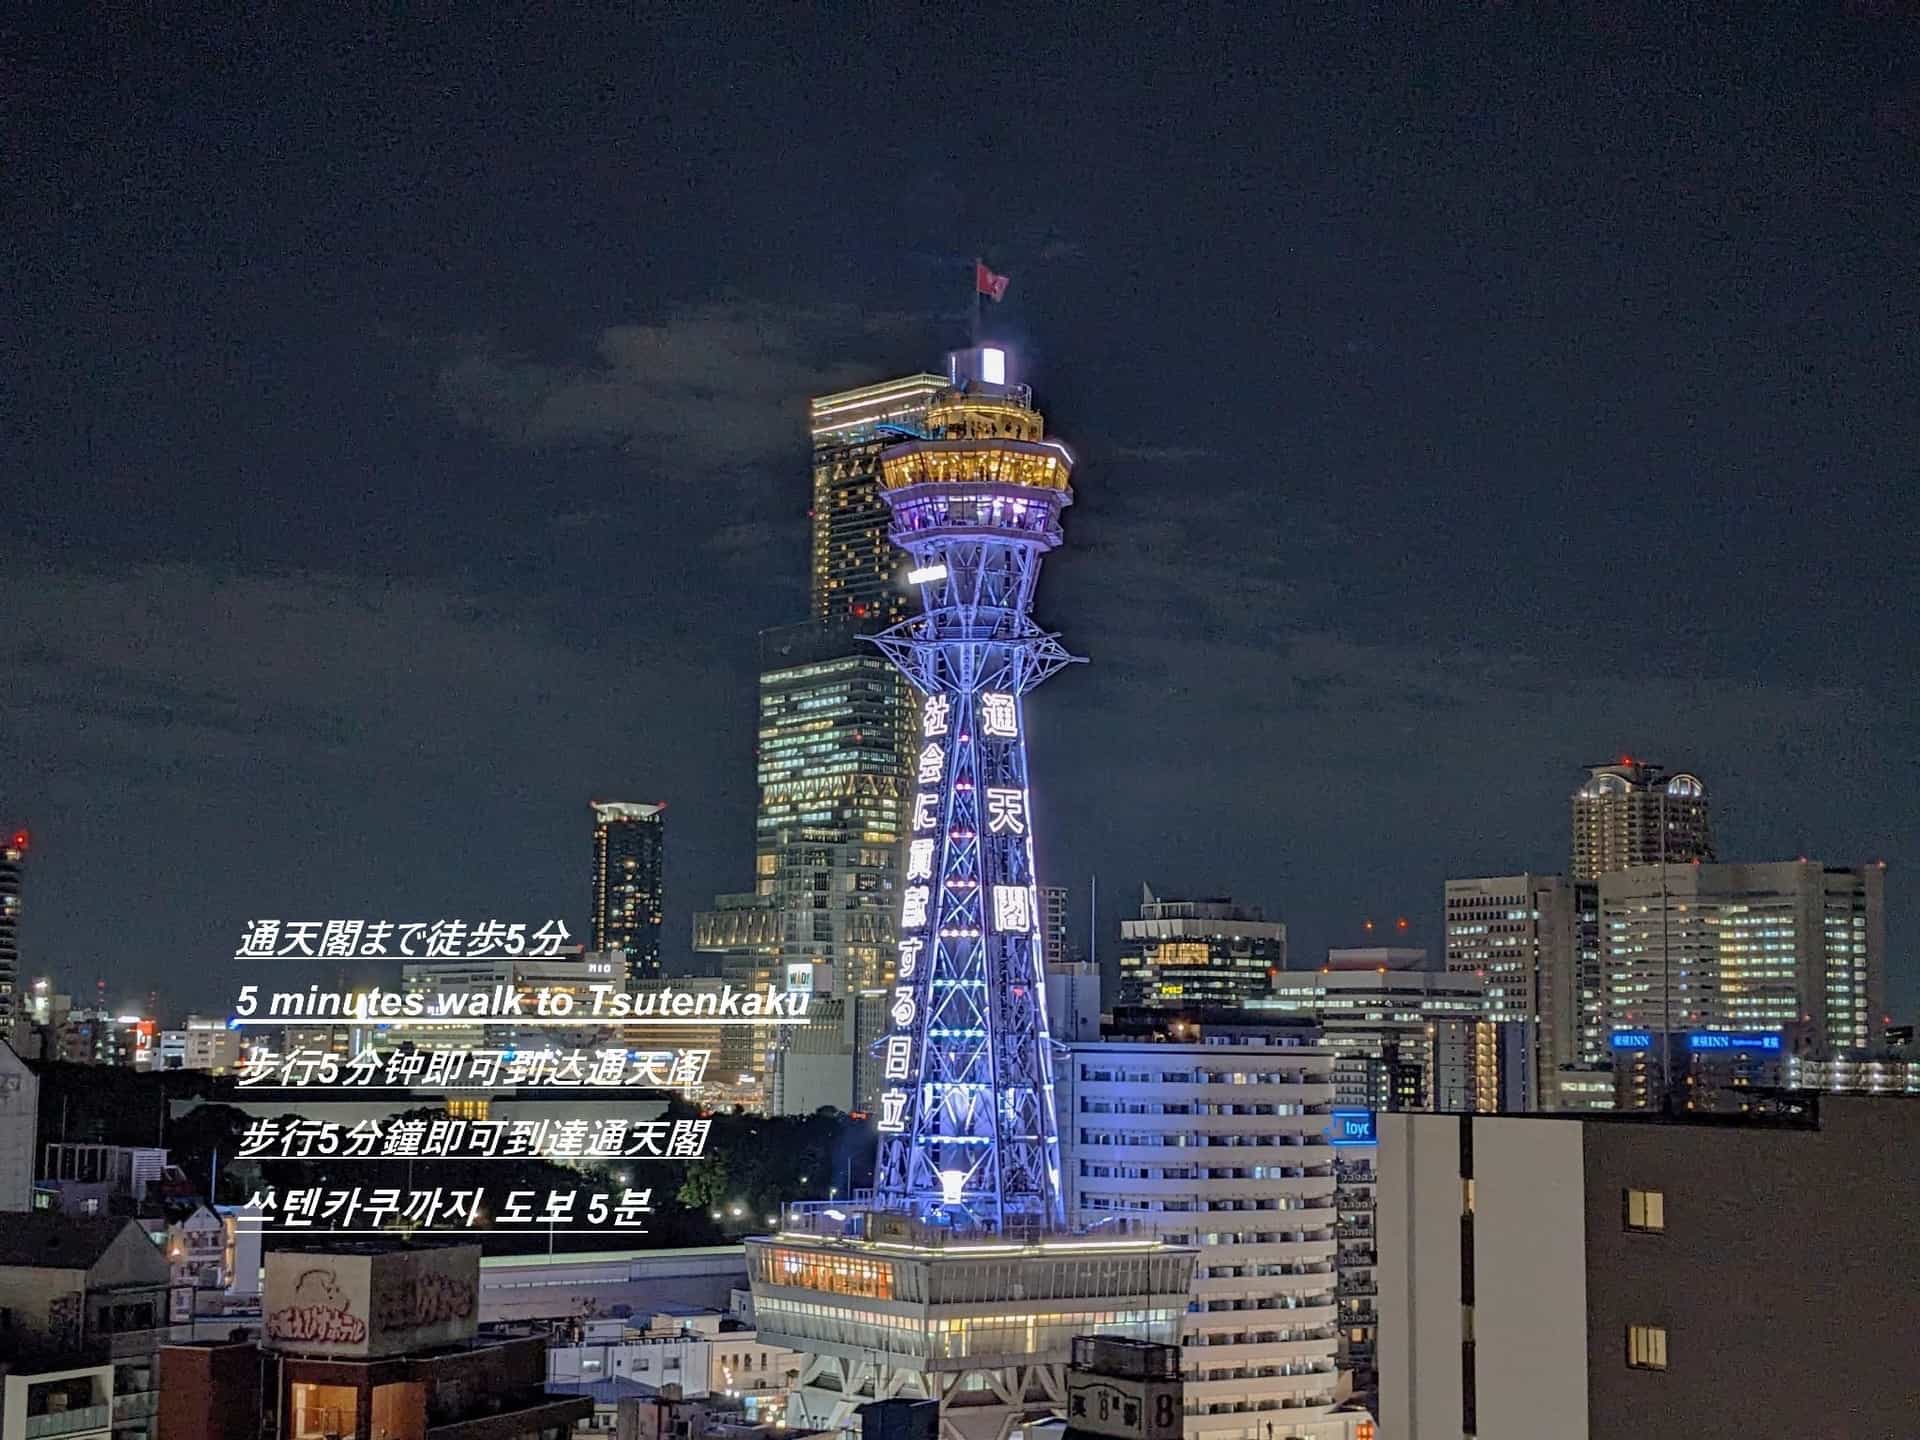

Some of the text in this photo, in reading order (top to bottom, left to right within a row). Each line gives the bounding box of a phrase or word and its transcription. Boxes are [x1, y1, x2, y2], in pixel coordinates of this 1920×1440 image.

[982, 691, 1031, 933] 通天閣
[1155, 1394, 1174, 1428] 8
